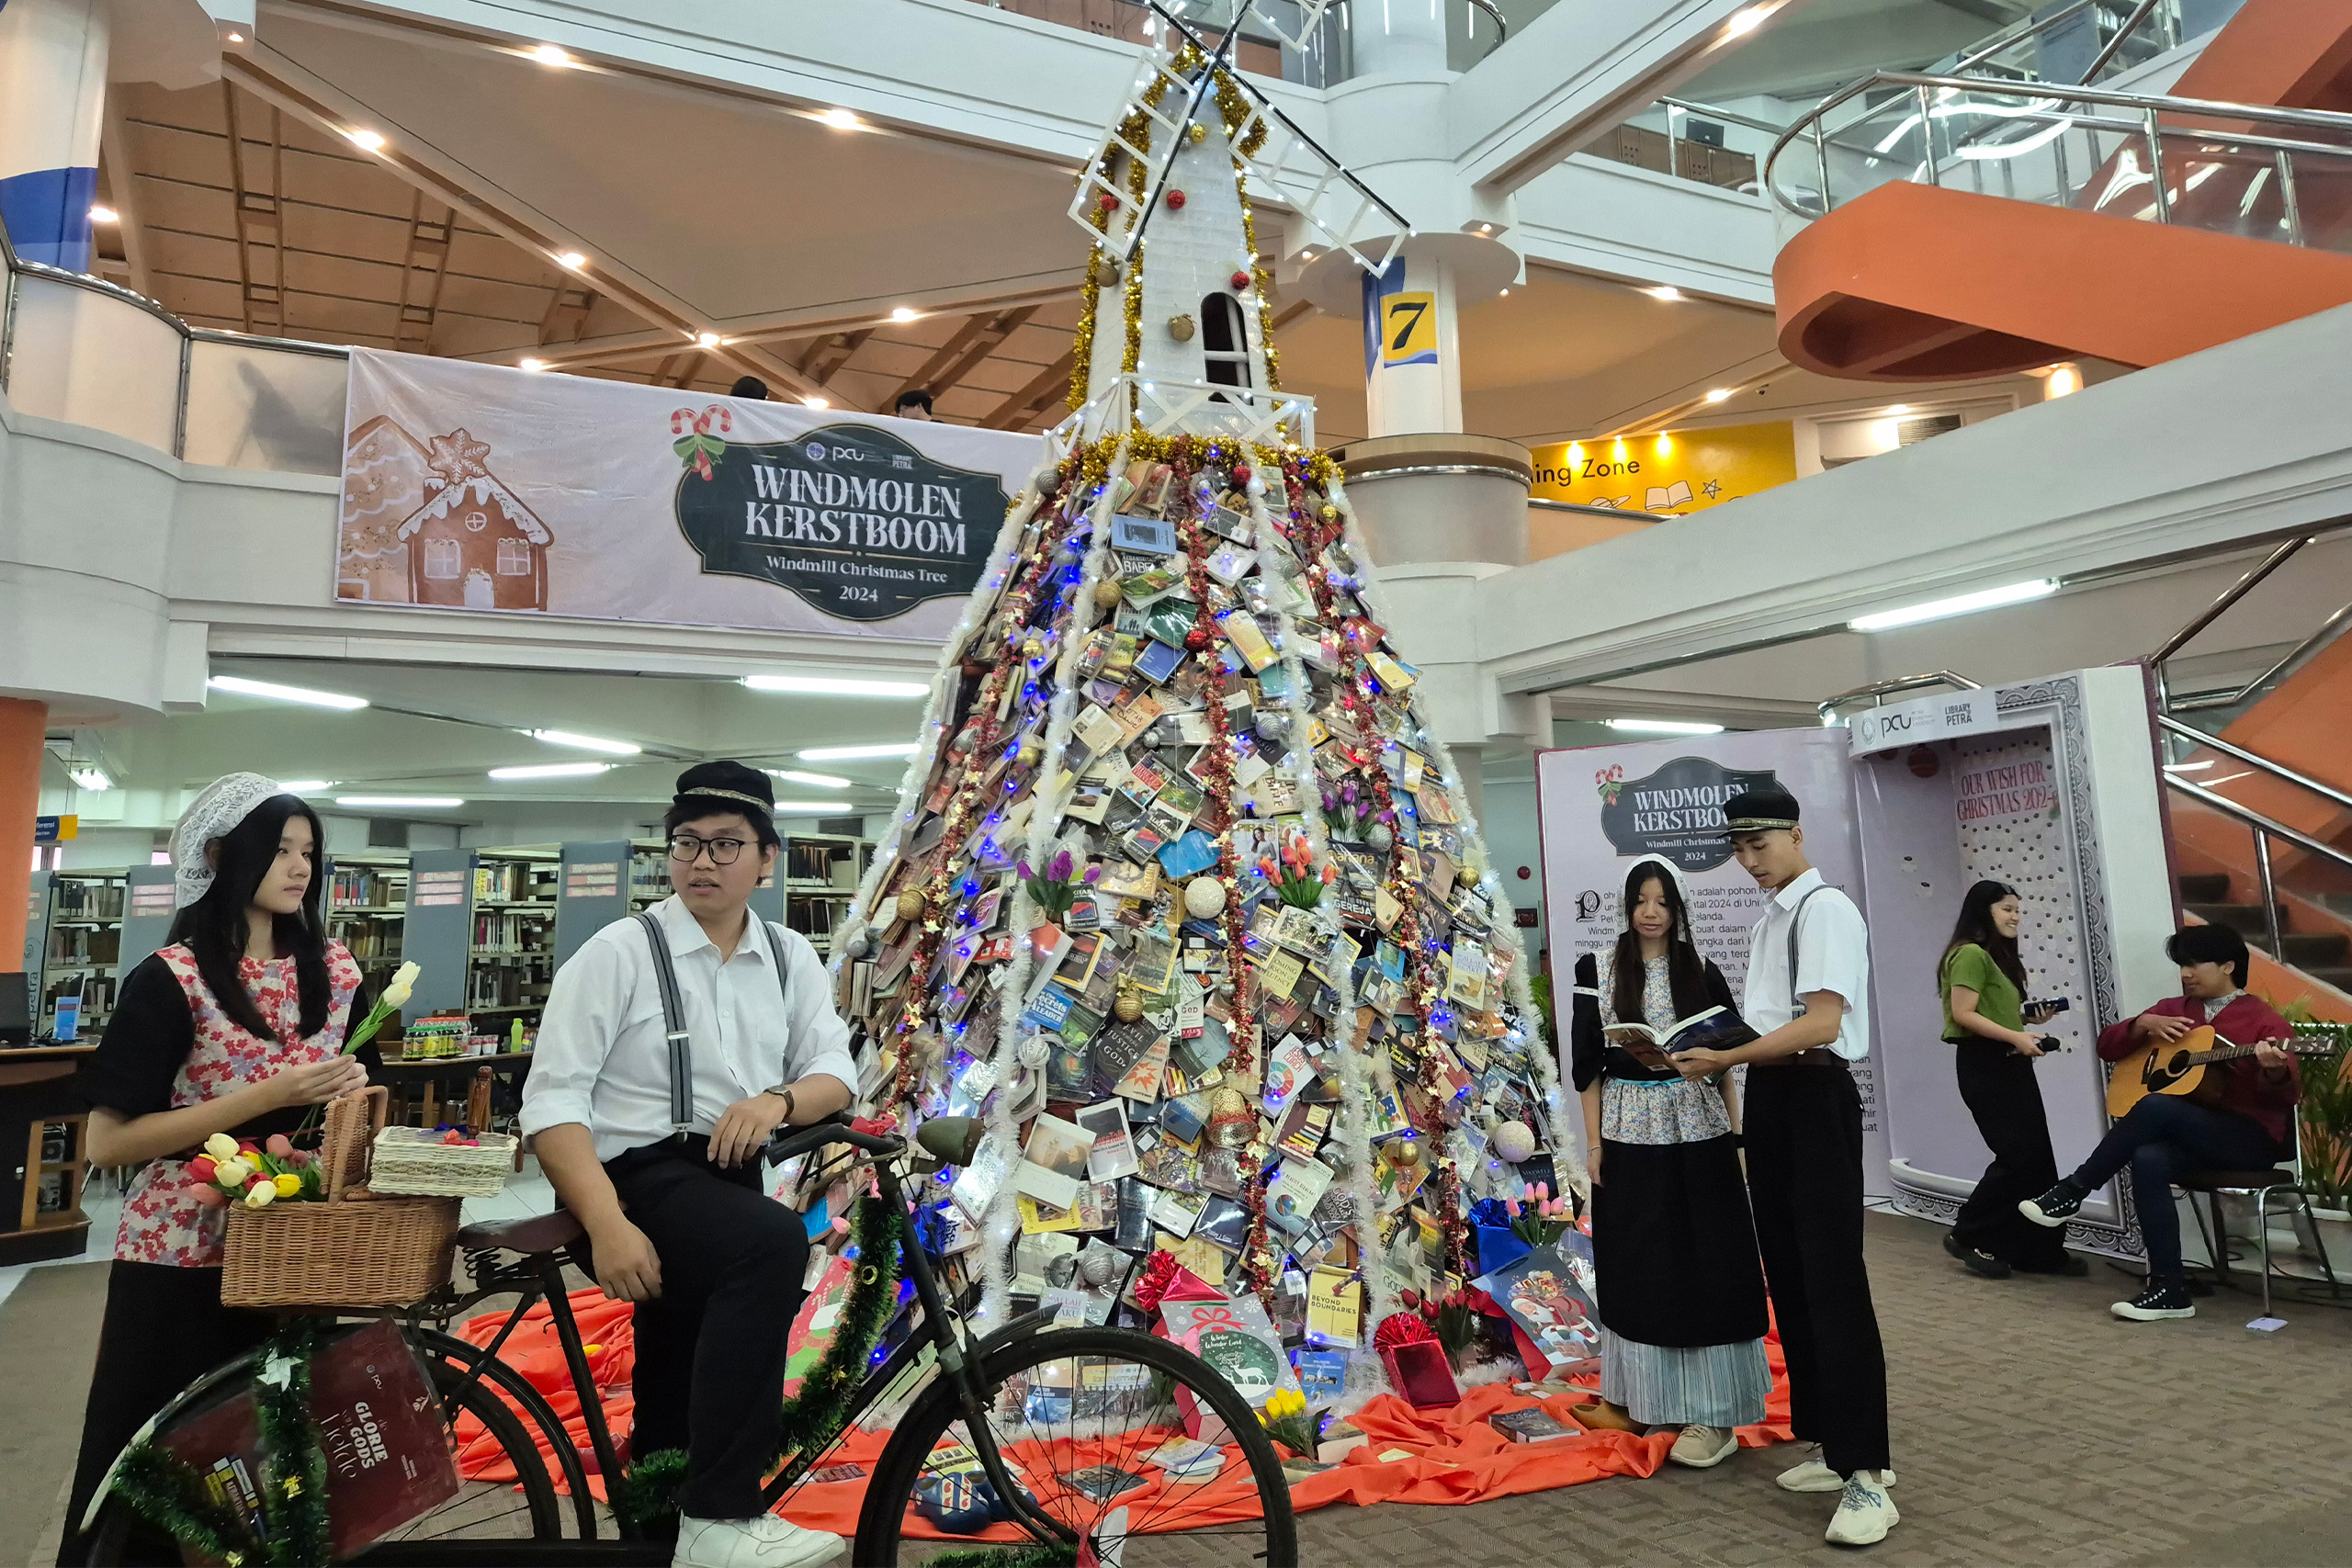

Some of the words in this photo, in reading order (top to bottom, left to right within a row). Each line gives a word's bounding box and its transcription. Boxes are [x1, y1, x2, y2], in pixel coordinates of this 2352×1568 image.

[1388, 301, 1429, 351] 7
[1531, 464, 1572, 487] ing
[1581, 458, 1640, 479] Zone
[751, 463, 963, 520] WINDMOLEN
[745, 502, 967, 556] KERSTBOOM
[765, 555, 836, 574] Windmill
[840, 562, 915, 581] Christmas
[917, 569, 948, 583] Tree
[1123, 560, 1155, 574] BABE
[839, 584, 879, 603] 2024
[1944, 703, 1972, 715] LIBRARY
[1946, 713, 1973, 727] PETRA
[1961, 773, 1984, 796] OUR
[1985, 765, 2018, 791] WISH
[2018, 760, 2047, 785] FOR
[1956, 790, 2021, 820] CHRISTMAS
[1645, 839, 1682, 849] Windmill
[1683, 836, 1726, 847] Christmas
[1684, 852, 1706, 862] 2024
[1697, 887, 1725, 897] adalah
[1727, 886, 1757, 897] pohon
[1333, 898, 1373, 917] GEREJA
[1708, 900, 1731, 908] 2024
[1733, 898, 1742, 908] di
[1588, 927, 1615, 935] Windm
[1718, 924, 1747, 933] dalam
[1575, 939, 1603, 949] minggu
[1727, 936, 1744, 945] dari
[1731, 950, 1749, 959] terd
[1035, 1005, 1063, 1023] LEADER
[1123, 1023, 1145, 1042] EVIL
[1106, 1029, 1140, 1059] JUSTICE
[1311, 1294, 1341, 1306] BEYOND
[1310, 1301, 1358, 1315] BOUNDARIES
[1204, 1340, 1228, 1349] Wonder
[1210, 1334, 1229, 1342] Winter
[355, 1401, 390, 1462] GLORIE
[349, 1426, 377, 1470] GODS
[786, 1420, 844, 1480] GAZELLE
